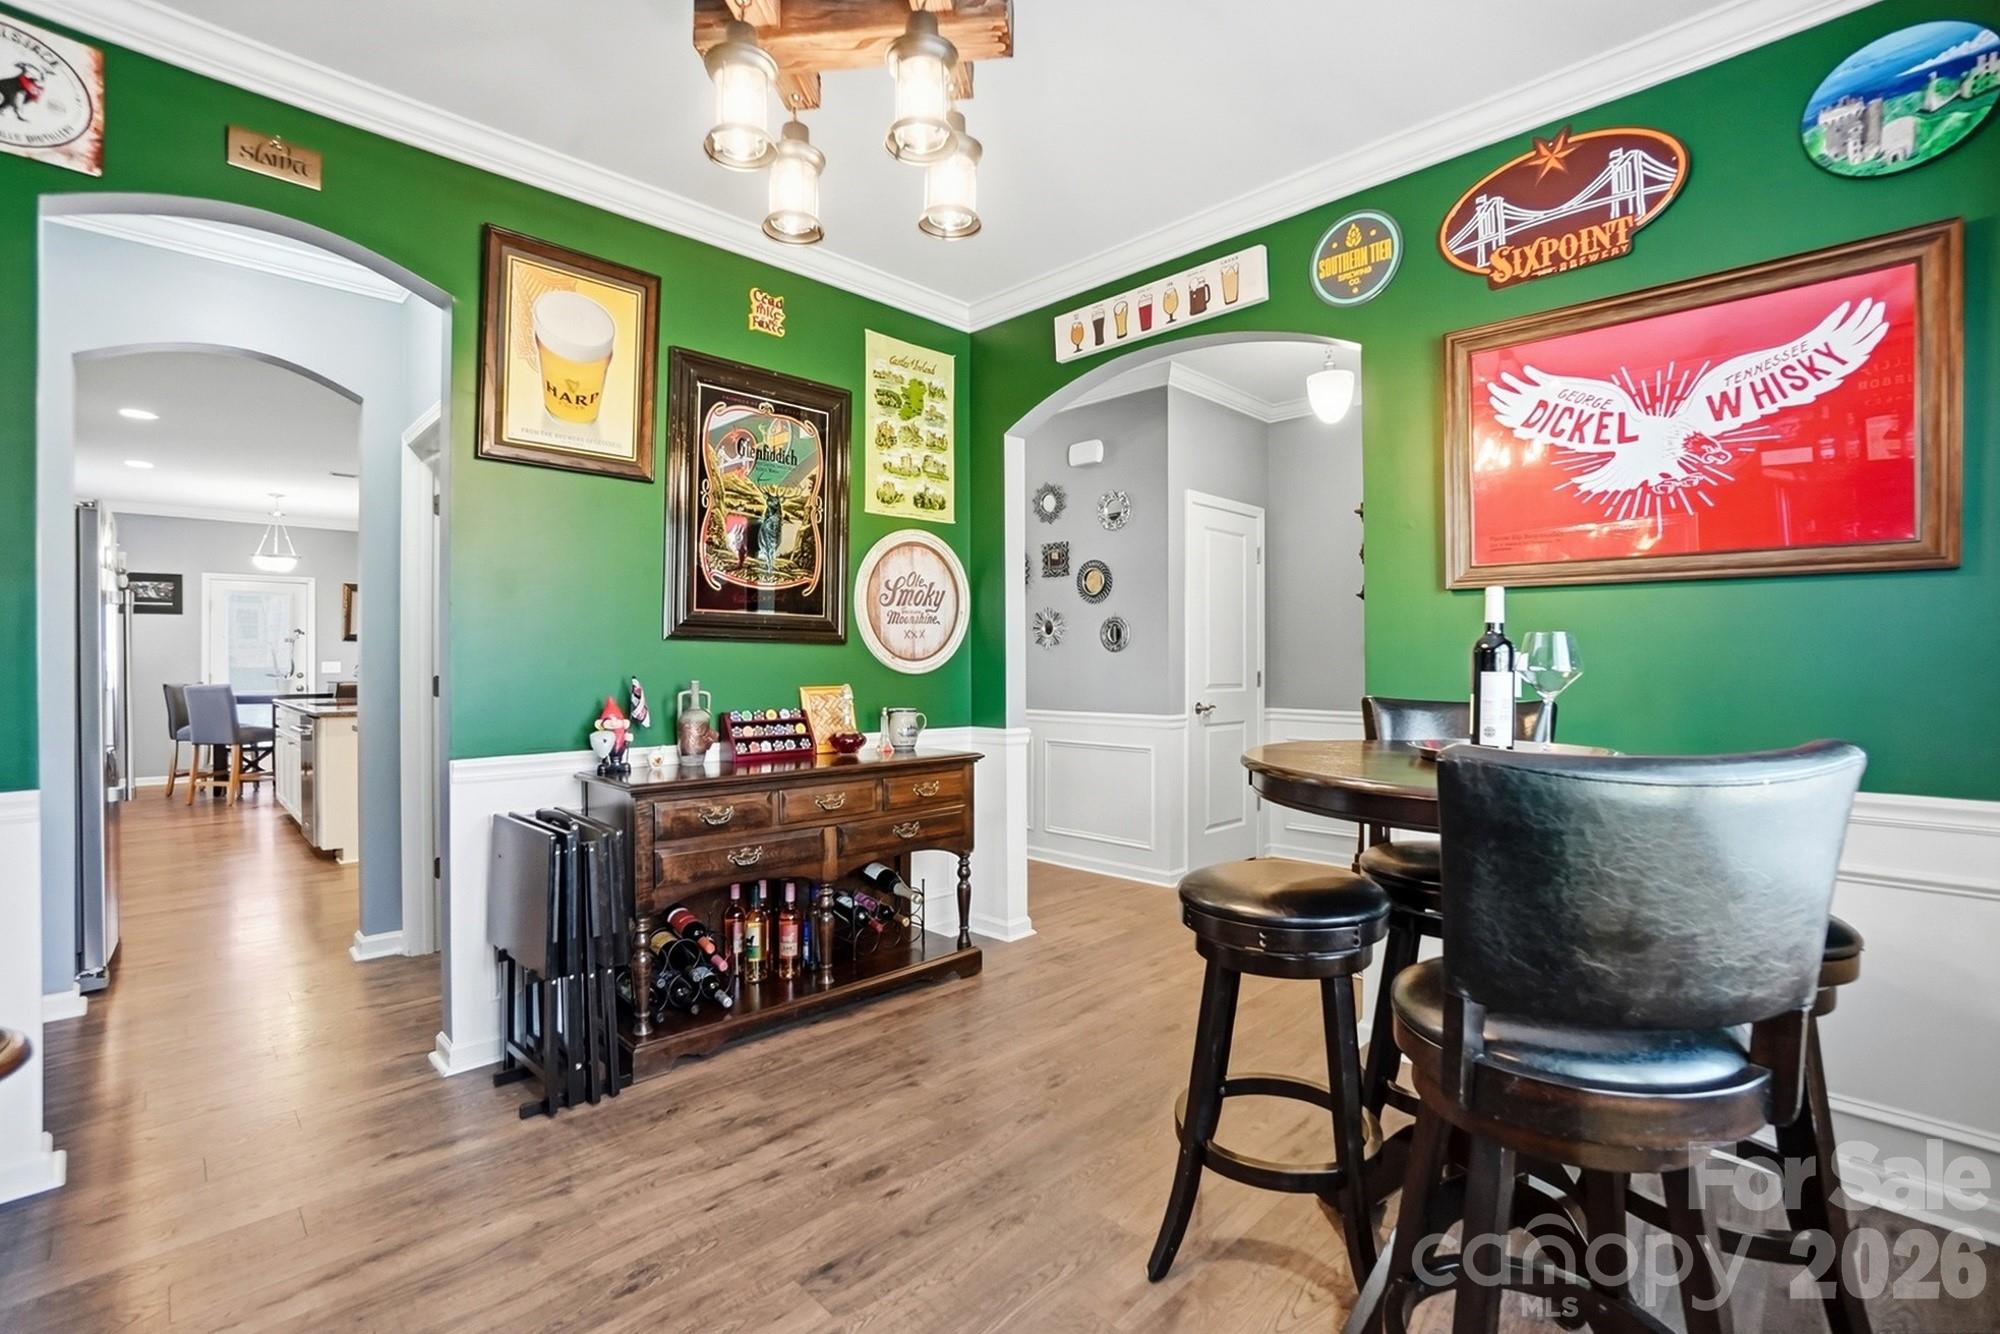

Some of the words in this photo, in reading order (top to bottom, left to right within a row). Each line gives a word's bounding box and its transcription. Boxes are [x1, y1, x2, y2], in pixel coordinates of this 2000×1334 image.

[1318, 246, 1369, 280] SOUTHERN
[1369, 238, 1393, 264] TIER
[1489, 215, 1634, 283] SIXPOINT
[1559, 243, 1630, 273] BREWERY
[1723, 340, 1809, 387] TENNESSEE
[545, 380, 600, 406] HARP
[1705, 341, 1849, 422] WHISKY
[1557, 388, 1614, 411] GEORGE
[1520, 399, 1639, 445] DICKEL
[736, 436, 798, 466] Glenfiddich
[879, 576, 946, 613] Smoky
[906, 571, 928, 588] Ole
[886, 609, 941, 625] Moonshine
